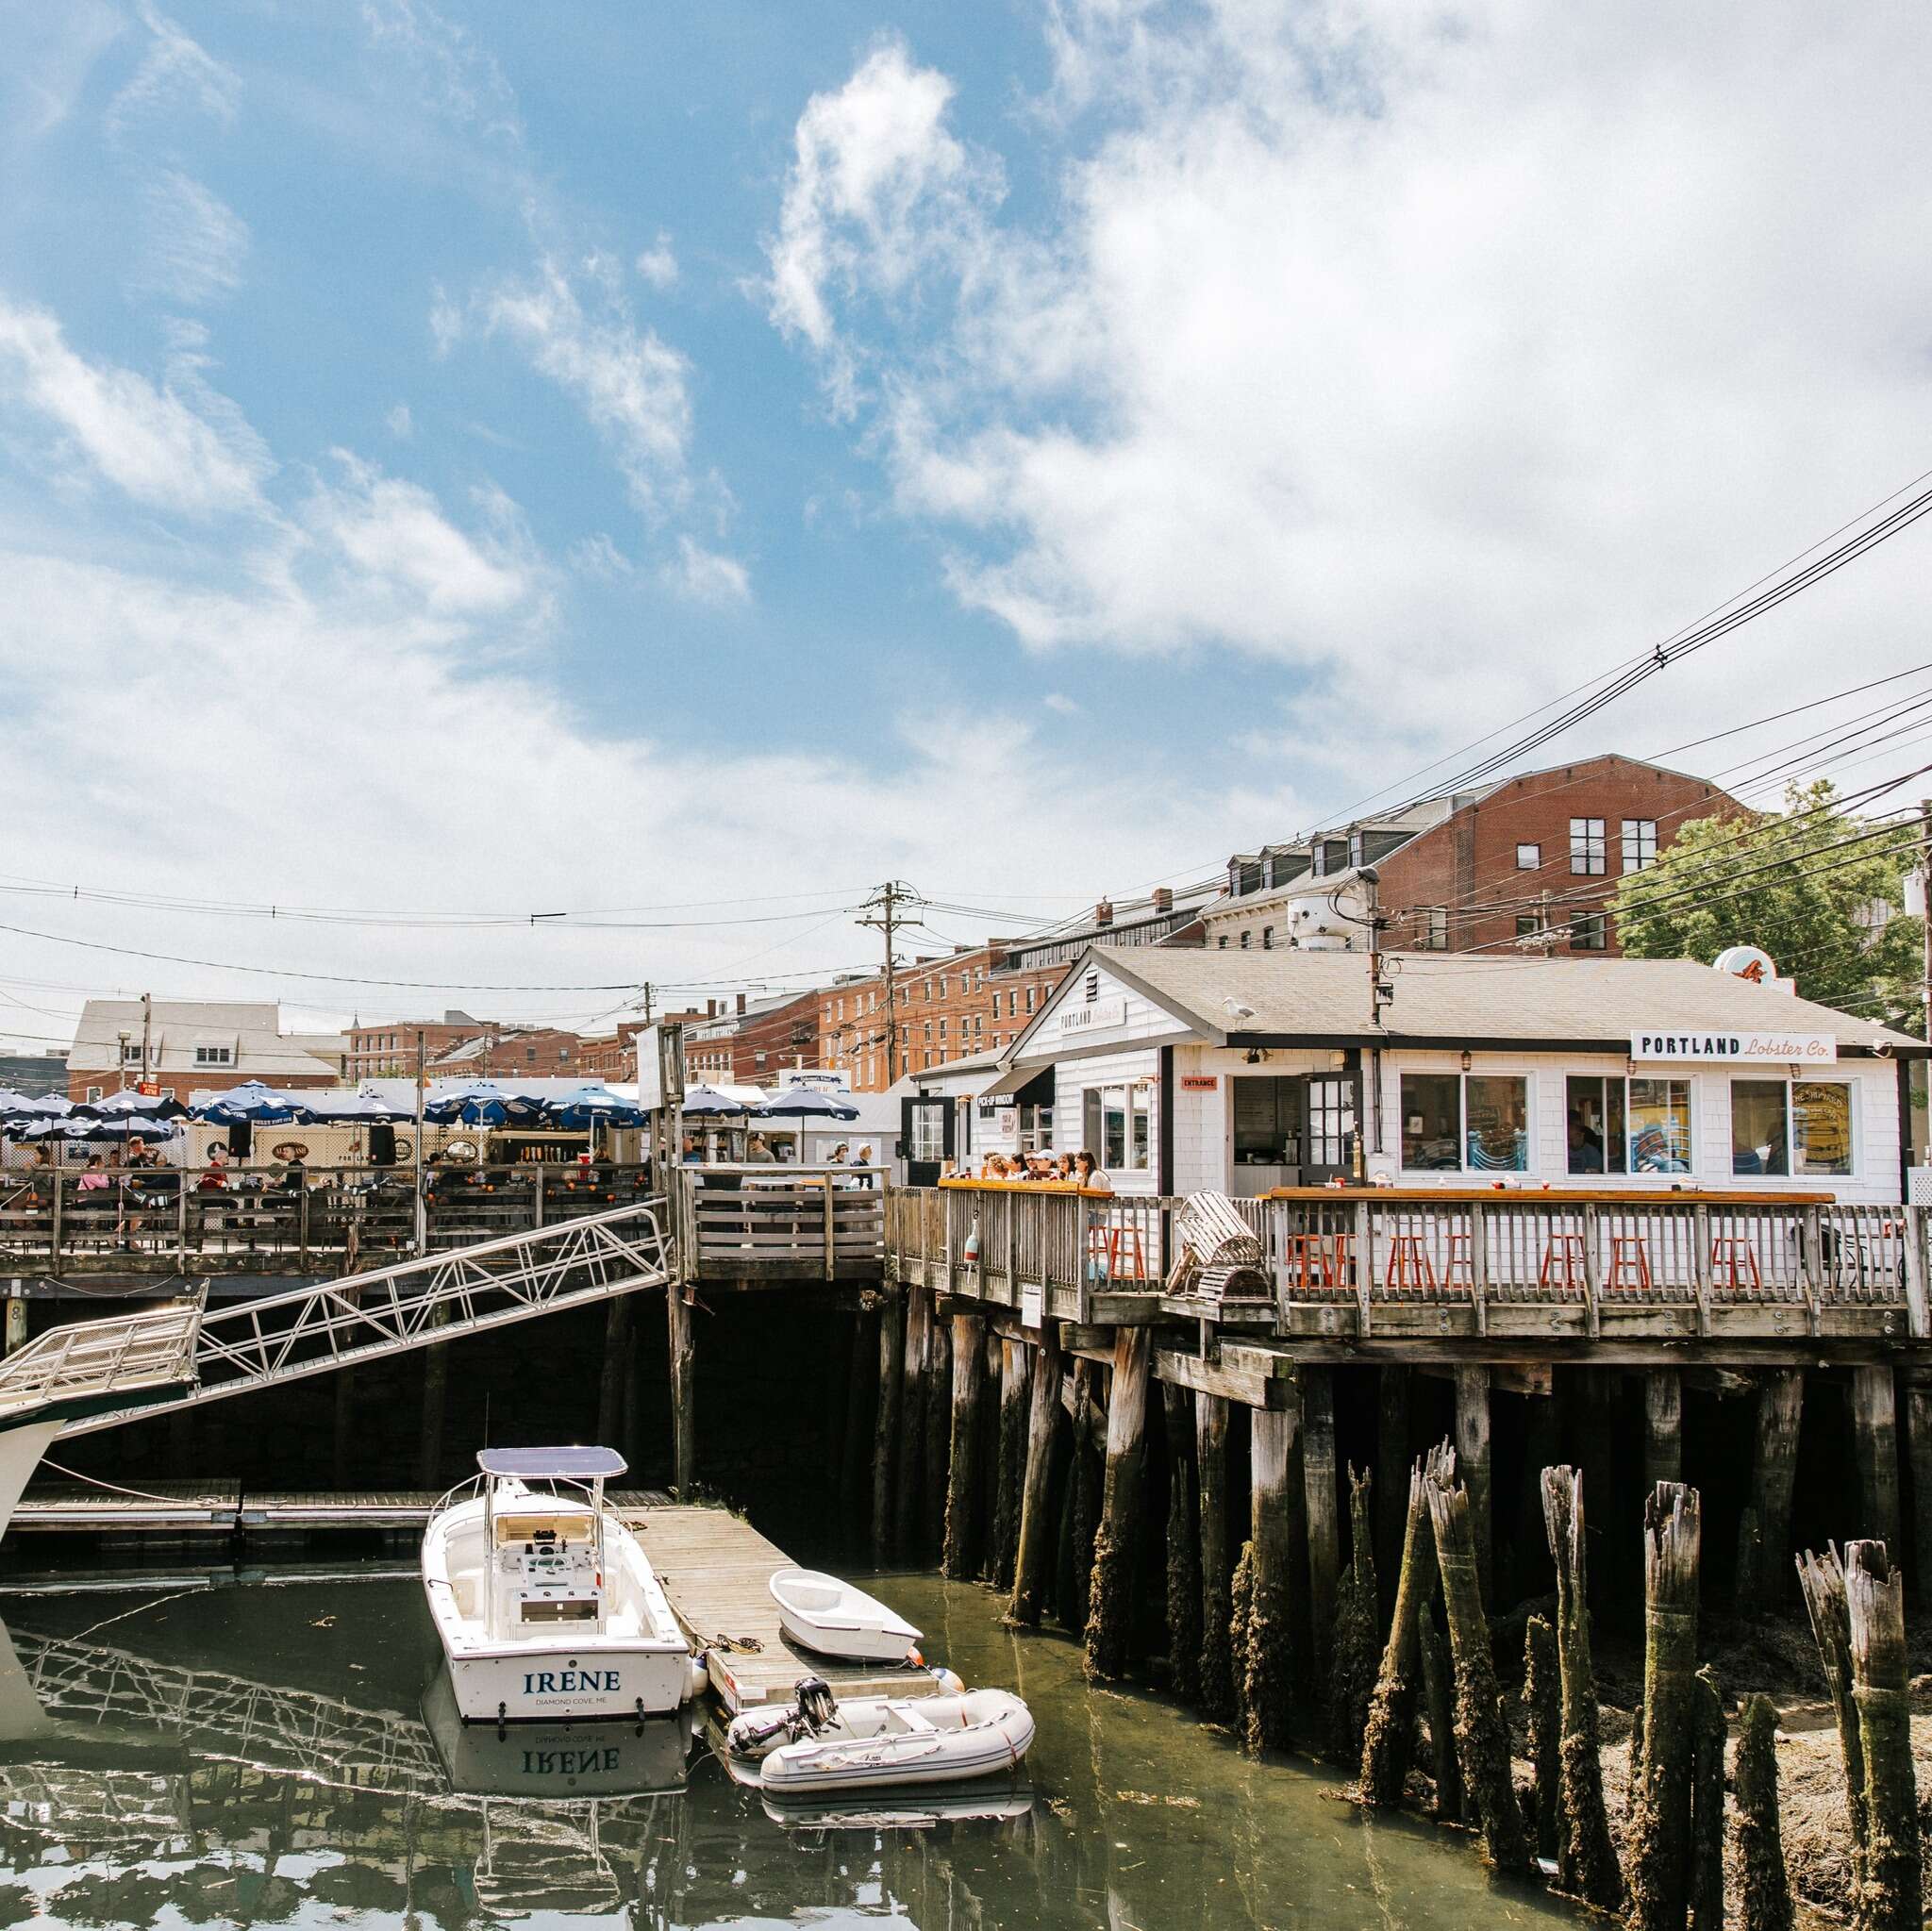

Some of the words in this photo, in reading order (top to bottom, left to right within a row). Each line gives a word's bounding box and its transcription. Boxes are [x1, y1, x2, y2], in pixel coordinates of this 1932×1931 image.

[1061, 1010, 1091, 1028] PORTLAND
[1641, 1037, 1740, 1055] PORTLAND
[1743, 1039, 1803, 1056] Lobster
[1806, 1040, 1829, 1057] Co.
[1184, 1079, 1215, 1088] ENTRANCE
[977, 1095, 995, 1107] PICK-UP
[995, 1093, 1015, 1105] WINDOW
[523, 1671, 622, 1694] IRENE
